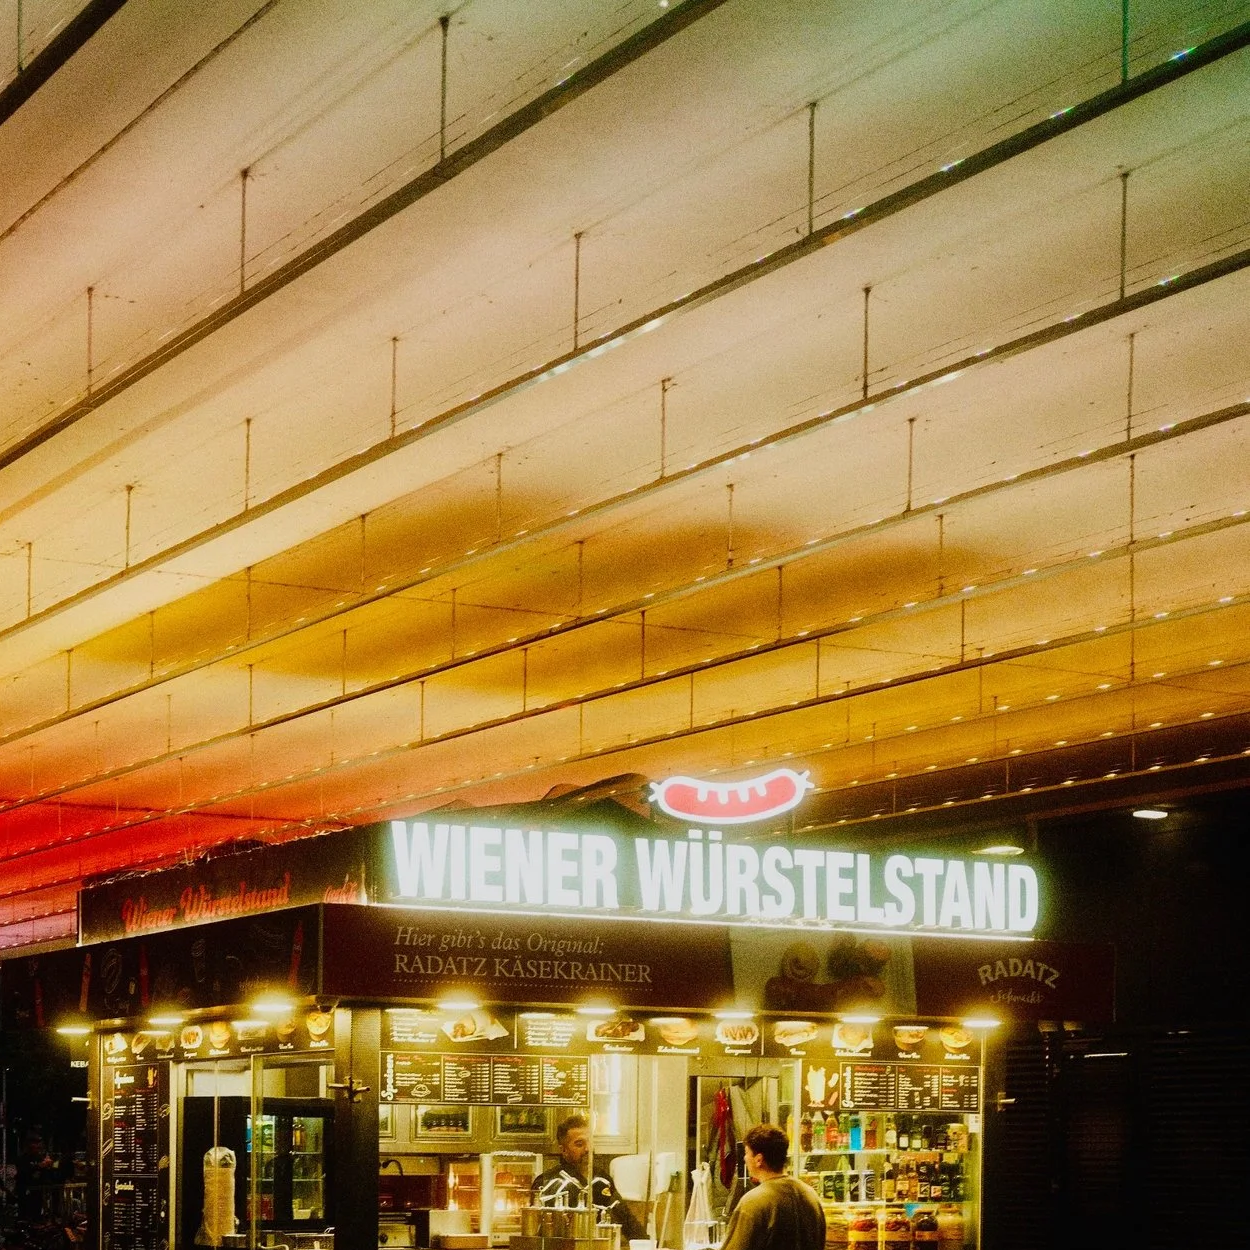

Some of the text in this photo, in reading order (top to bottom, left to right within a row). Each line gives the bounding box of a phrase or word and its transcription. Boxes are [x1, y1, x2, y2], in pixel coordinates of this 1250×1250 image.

[390, 820, 1038, 932] WIENER WÜRSTELSTAND
[394, 926, 605, 957] Hier gibt's das Original:
[393, 953, 652, 984] RADATZ KÄSEKRAINER
[977, 958, 1061, 989] RADATZ
